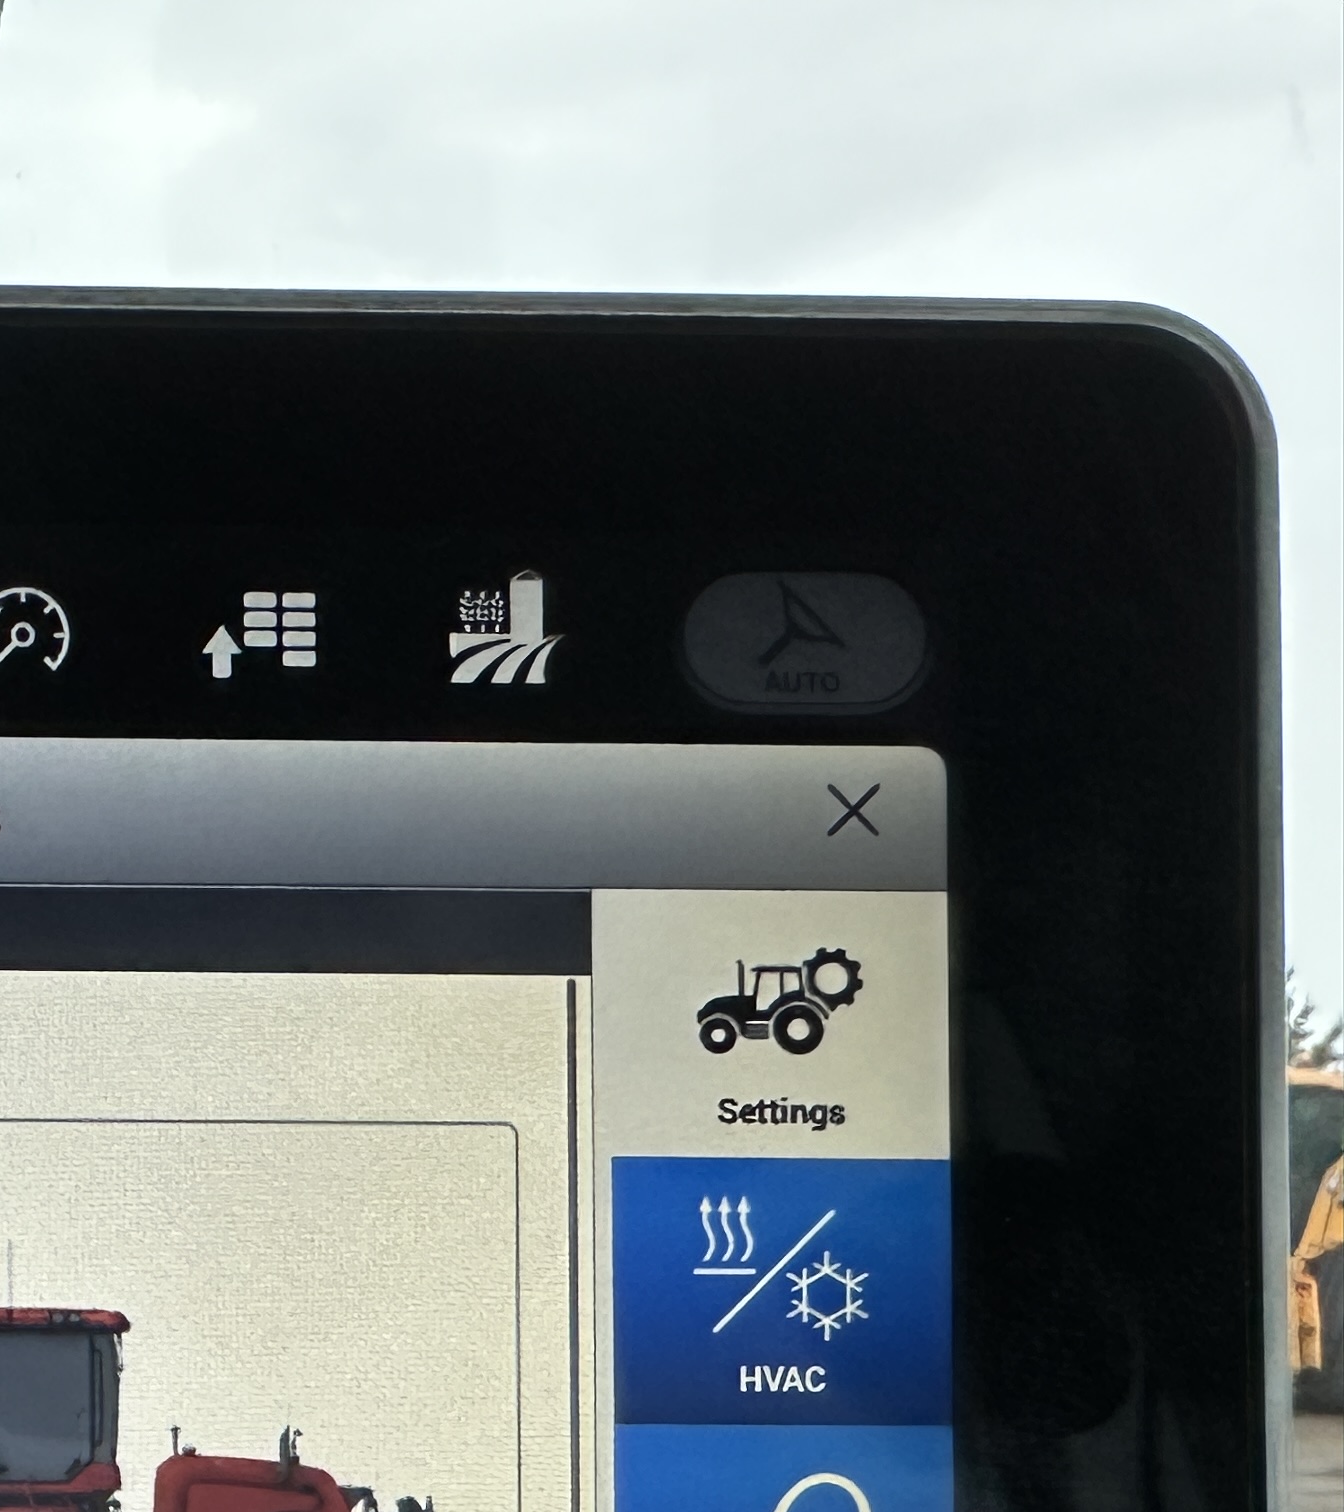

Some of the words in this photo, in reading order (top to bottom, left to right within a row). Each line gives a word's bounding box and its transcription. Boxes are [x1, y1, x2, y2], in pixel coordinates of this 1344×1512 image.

[765, 670, 840, 694] AUTO
[718, 1097, 845, 1131] Settings
[740, 1366, 825, 1392] HVAC
